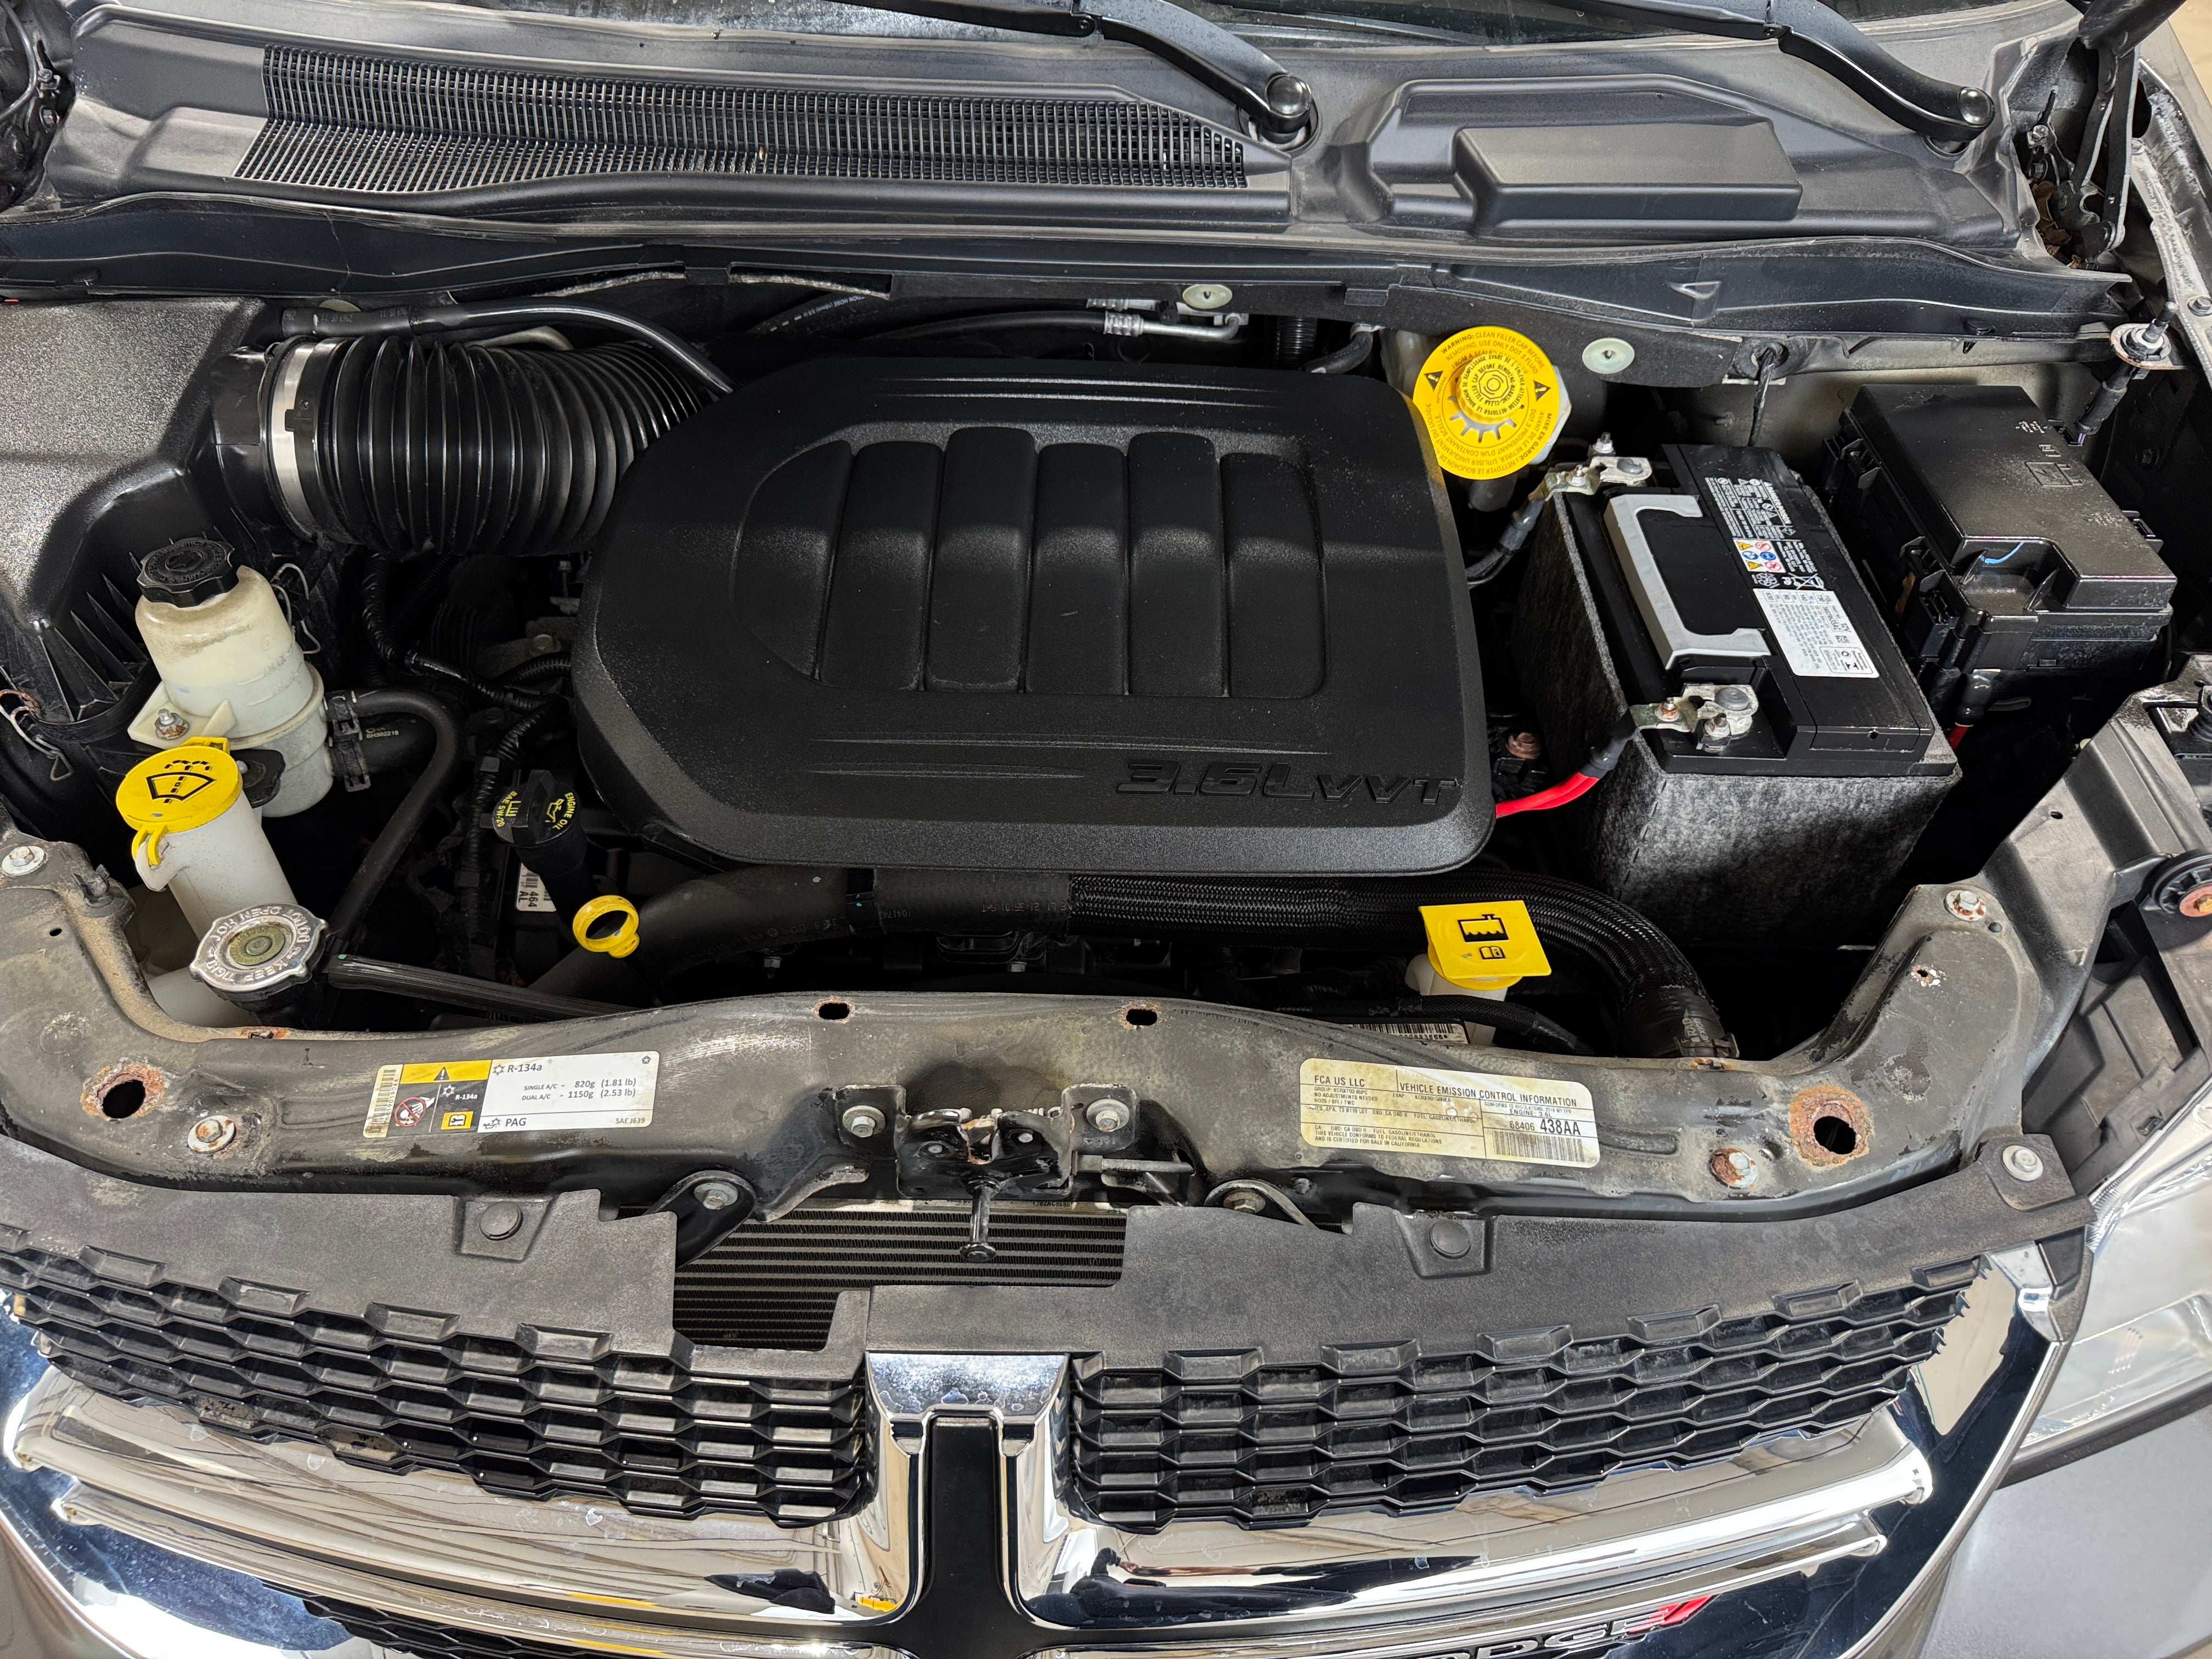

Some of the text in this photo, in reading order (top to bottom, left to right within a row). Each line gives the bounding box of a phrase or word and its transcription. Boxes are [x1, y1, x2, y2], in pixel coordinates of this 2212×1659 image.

[1441, 334, 1474, 354] WARNING:
[1497, 332, 1516, 343] FILLER
[1516, 340, 1528, 349] CAP
[1527, 347, 1545, 369] BEFORE
[1492, 340, 1509, 349] ONLY
[1509, 345, 1522, 356] DOT
[1525, 357, 1538, 375] FLUID
[1452, 355, 1468, 369] FROM
[1477, 363, 1496, 374] BEFORE
[1426, 404, 1435, 431] LIQUIDE
[1528, 409, 1536, 420] DOT
[1533, 411, 1544, 433] AVANT
[1542, 413, 1552, 430] MISE
[1432, 430, 1440, 439] DU
[1497, 427, 1527, 454] PROVENANT
[1528, 432, 1536, 441] DE
[1536, 430, 1544, 441] EN
[1437, 438, 1470, 465] UNIQUEMENT
[1446, 436, 1480, 456] CONTENANT
[1519, 441, 1538, 459] GARDE
[1522, 441, 1528, 449] LE
[1439, 453, 1448, 462] DE
[1471, 455, 1498, 466] UTILISER
[1447, 459, 1476, 474] BOUCHON
[1485, 459, 1515, 474] NETTOYER
[1841, 623, 1851, 633] 12V
[1116, 758, 1460, 806] 3.6L VVT
[495, 791, 518, 828] SAE 5W-20
[552, 792, 577, 831] ENGINE OIL
[518, 891, 528, 903] AL
[528, 891, 539, 908] 464
[240, 906, 283, 922] OPEN
[210, 918, 238, 941] HOT
[206, 960, 289, 982] KEEP TIGHT
[507, 1063, 543, 1073] R-134a
[574, 1080, 595, 1088] 820g
[601, 1079, 623, 1088] (1.81
[625, 1078, 636, 1087] lb)
[1314, 1075, 1365, 1087] FCA US LLC
[568, 1091, 594, 1099] 1150g
[601, 1089, 622, 1098] (2.53
[624, 1088, 636, 1097] lb)
[1400, 1082, 1577, 1107] VEHICLE EMISSION CONTROL INFORMATION
[505, 1118, 527, 1127] PAG
[1509, 1118, 1581, 1136] 68406 438AA
[1408, 1136, 1442, 1144] REGULATIONS
